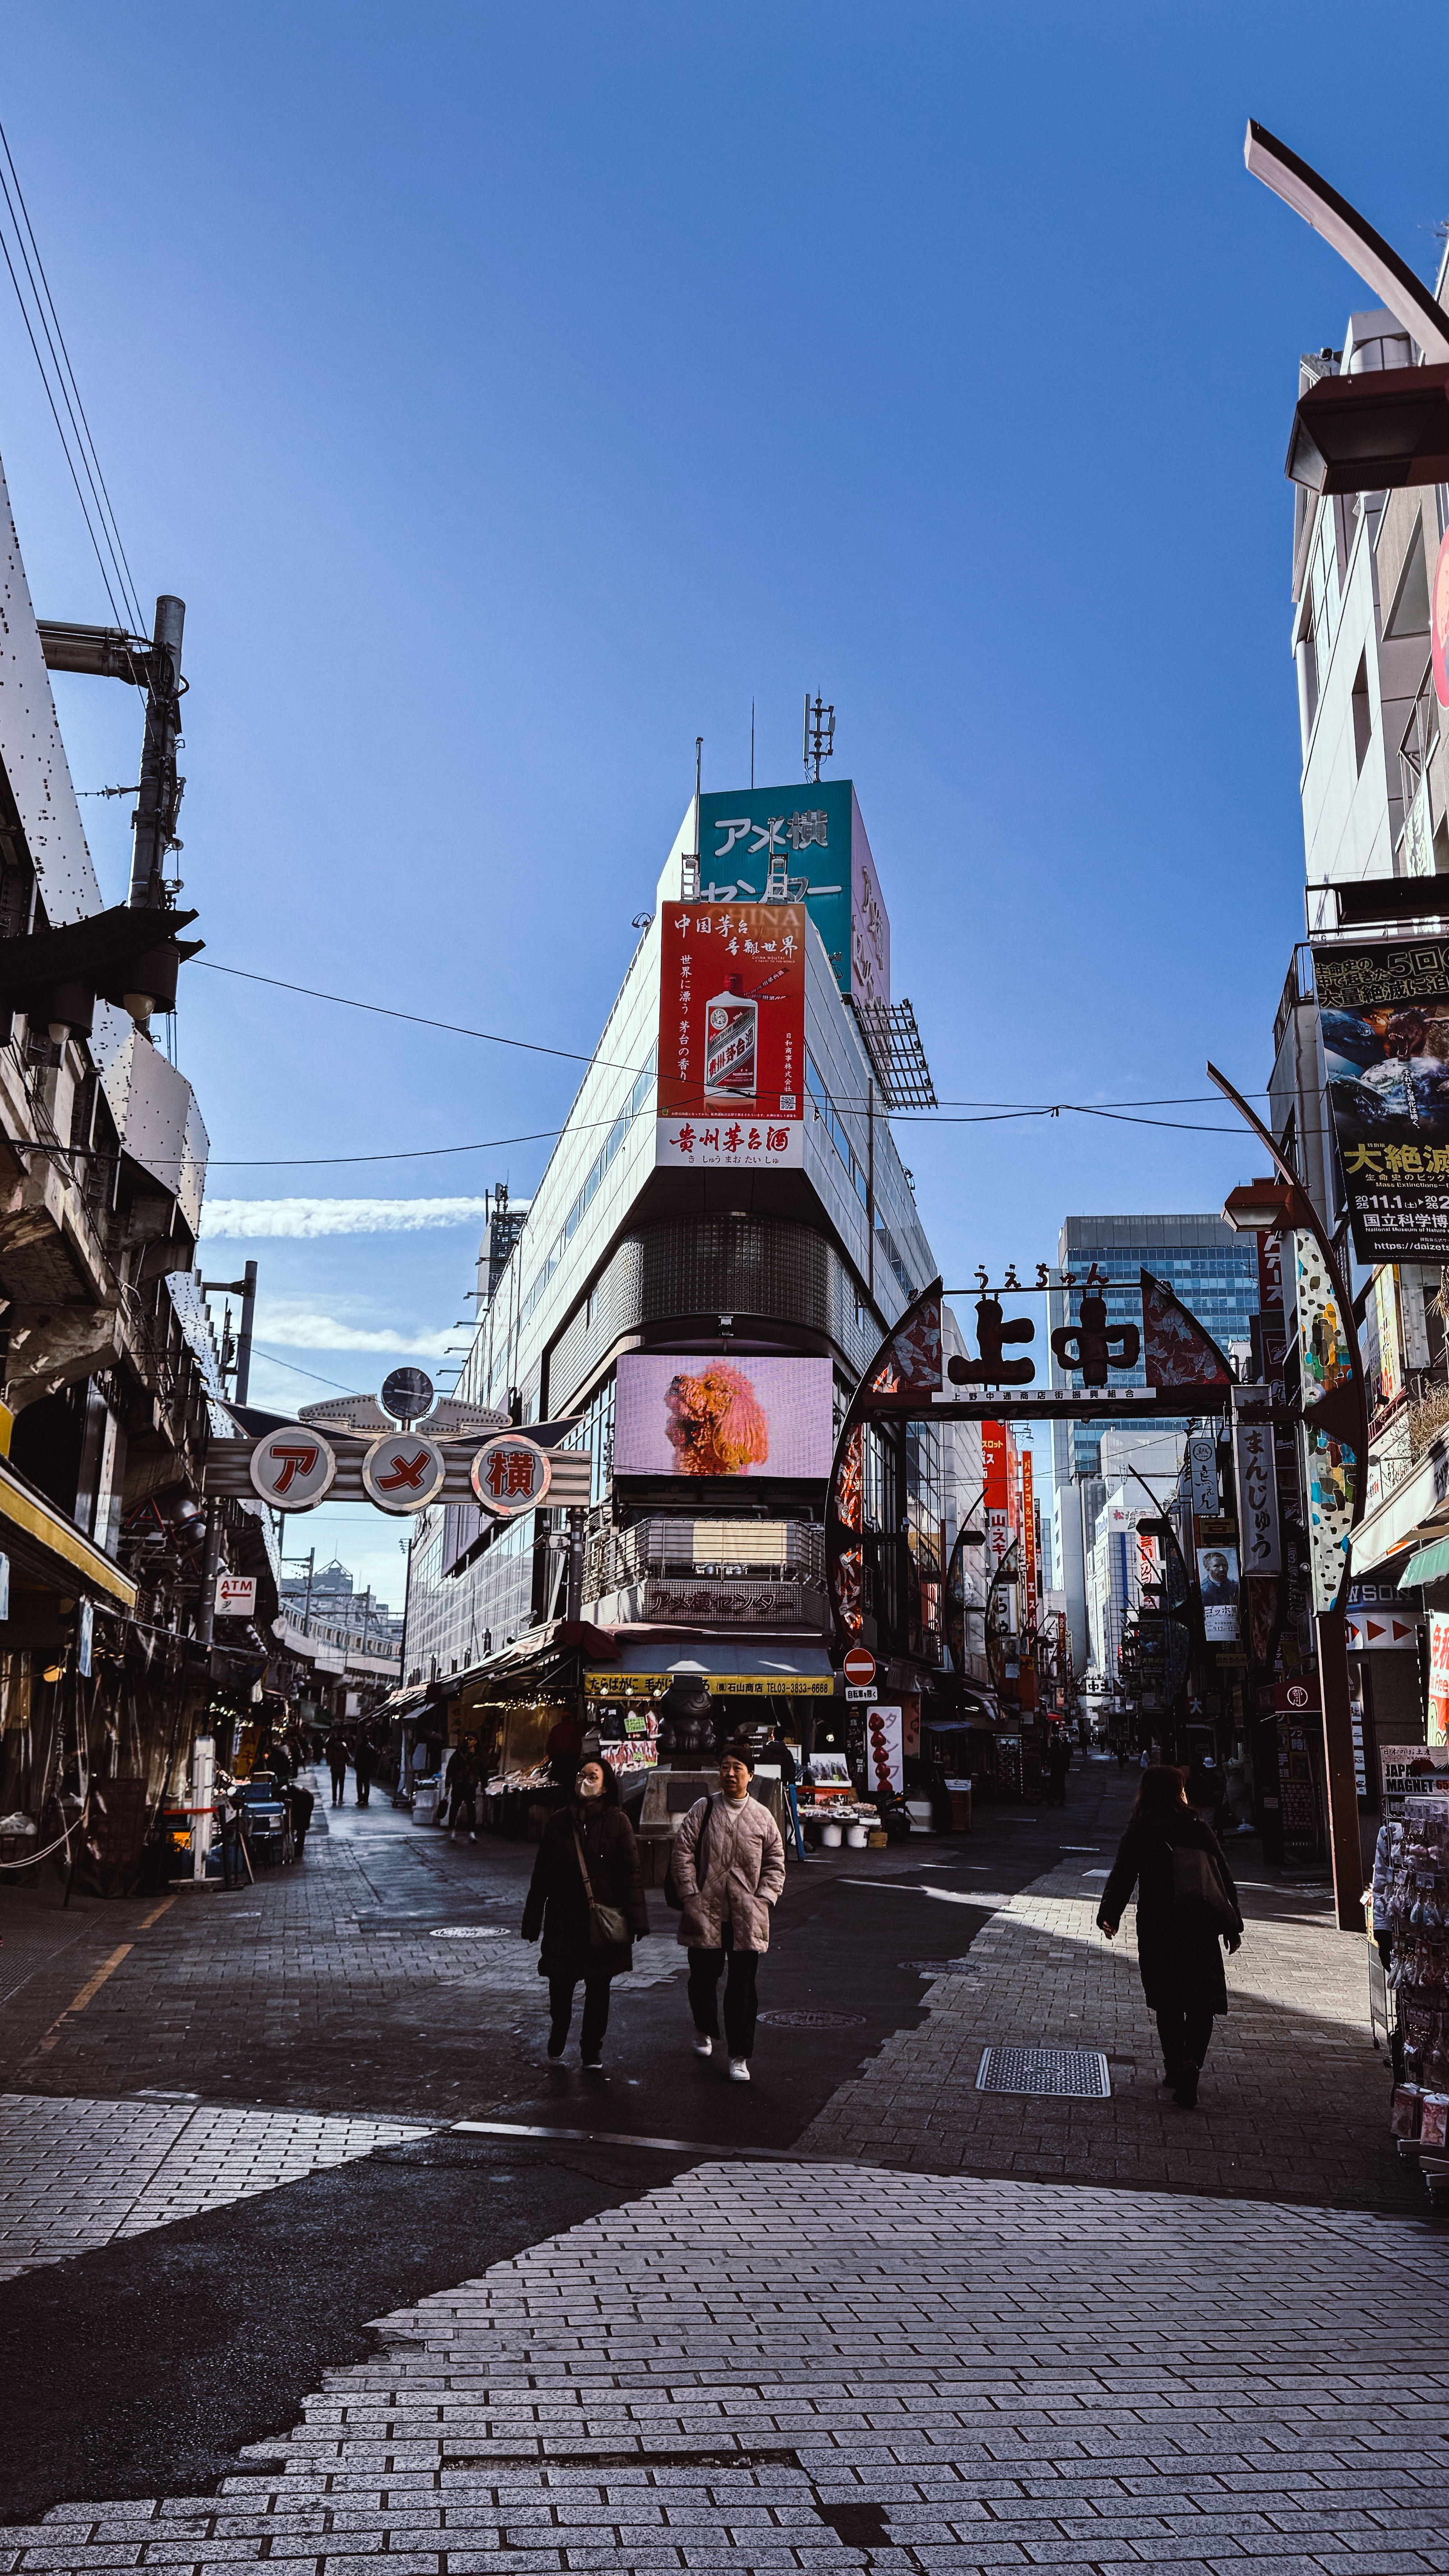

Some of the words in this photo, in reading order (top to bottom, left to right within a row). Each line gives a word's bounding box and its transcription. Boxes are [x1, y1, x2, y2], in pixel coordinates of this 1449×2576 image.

[714, 809, 828, 856] アメ横
[675, 914, 750, 938] 中国茅台
[1314, 957, 1373, 975] 生命史の
[1388, 946, 1449, 977] 5回
[679, 954, 693, 1015] 世界に漂う
[1316, 968, 1390, 988] 中で起きた
[677, 1021, 690, 1083] 茅台の香り
[784, 1033, 792, 1092] 日和商事株式会社
[1403, 1069, 1420, 1129] それでも進化は続く。
[725, 1155, 741, 1164] まお
[745, 1155, 761, 1164] たい
[1369, 1195, 1403, 1208] 11.1
[1363, 1213, 1449, 1228] 国立科学博
[974, 1262, 1110, 1290] うえちゅん
[948, 1297, 1141, 1386] 上中
[952, 1389, 1134, 1401] 上野中通商店街振興組合
[271, 1445, 535, 1498] アメ横
[221, 1580, 252, 1591] ATM
[652, 1591, 793, 1612] アメ横センター
[591, 1678, 639, 1690] たらばがに
[767, 1683, 828, 1693] TEL03-3833-6668
[848, 1689, 876, 1698] 自転車を除く
[1385, 1764, 1421, 1777] JAPAN
[1386, 1778, 1434, 1792] MAGNET
